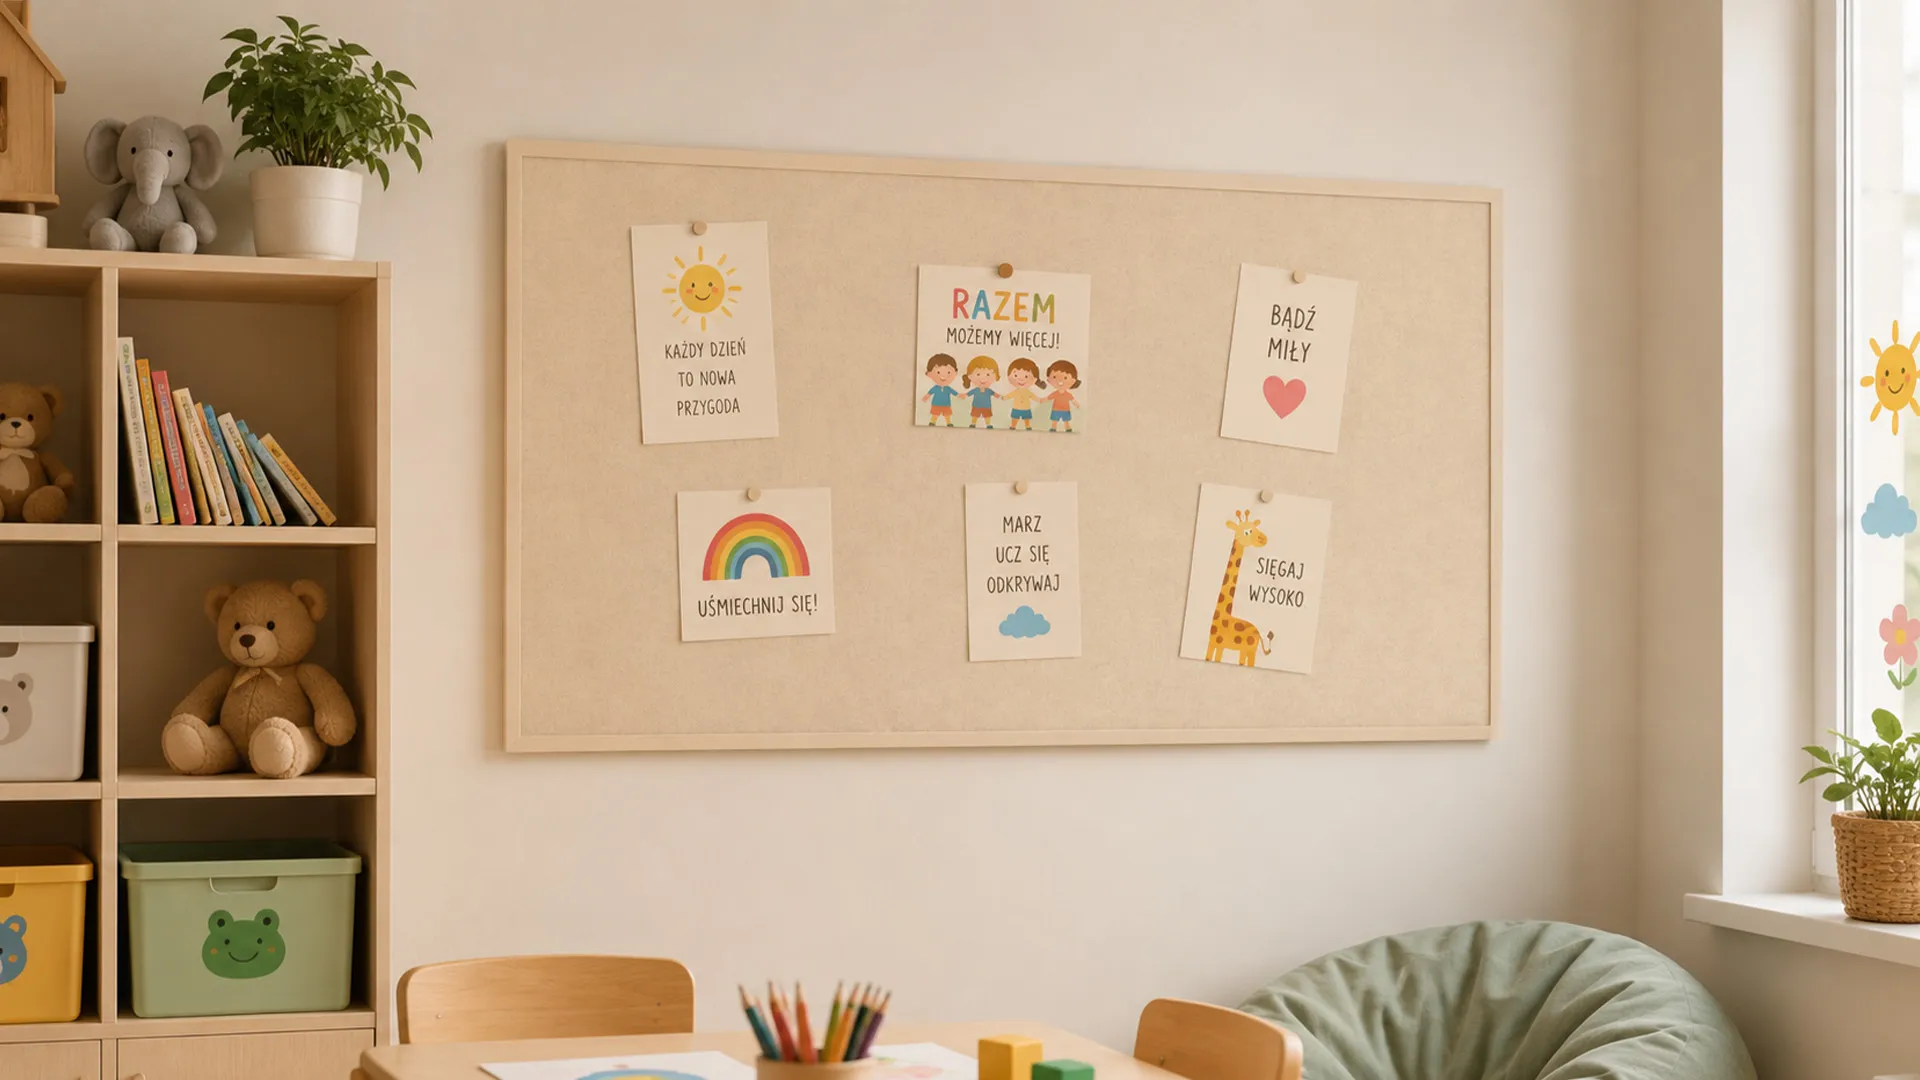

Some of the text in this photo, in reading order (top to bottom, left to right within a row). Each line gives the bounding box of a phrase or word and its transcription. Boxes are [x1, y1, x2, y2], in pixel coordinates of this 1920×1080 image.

[952, 287, 1055, 324] RAZEM
[1270, 303, 1316, 332] BĄDŹ
[665, 337, 746, 359] KAŻDY DZIEŃ
[946, 325, 1060, 351] MOŻEMY WIĘCEJ!
[1267, 337, 1311, 363] MIŁY
[678, 370, 736, 387] TO NOWA
[677, 398, 740, 416] PRZYGODA
[1003, 515, 1042, 533] MARZ
[995, 545, 1050, 565] UCZ SIĘ
[1256, 557, 1305, 580] SIĘGAJ
[986, 574, 1060, 593] ODKRYWAJ
[698, 593, 818, 618] UŚMIECHNIJ SIĘ!
[1249, 584, 1305, 608] WYSOKO
